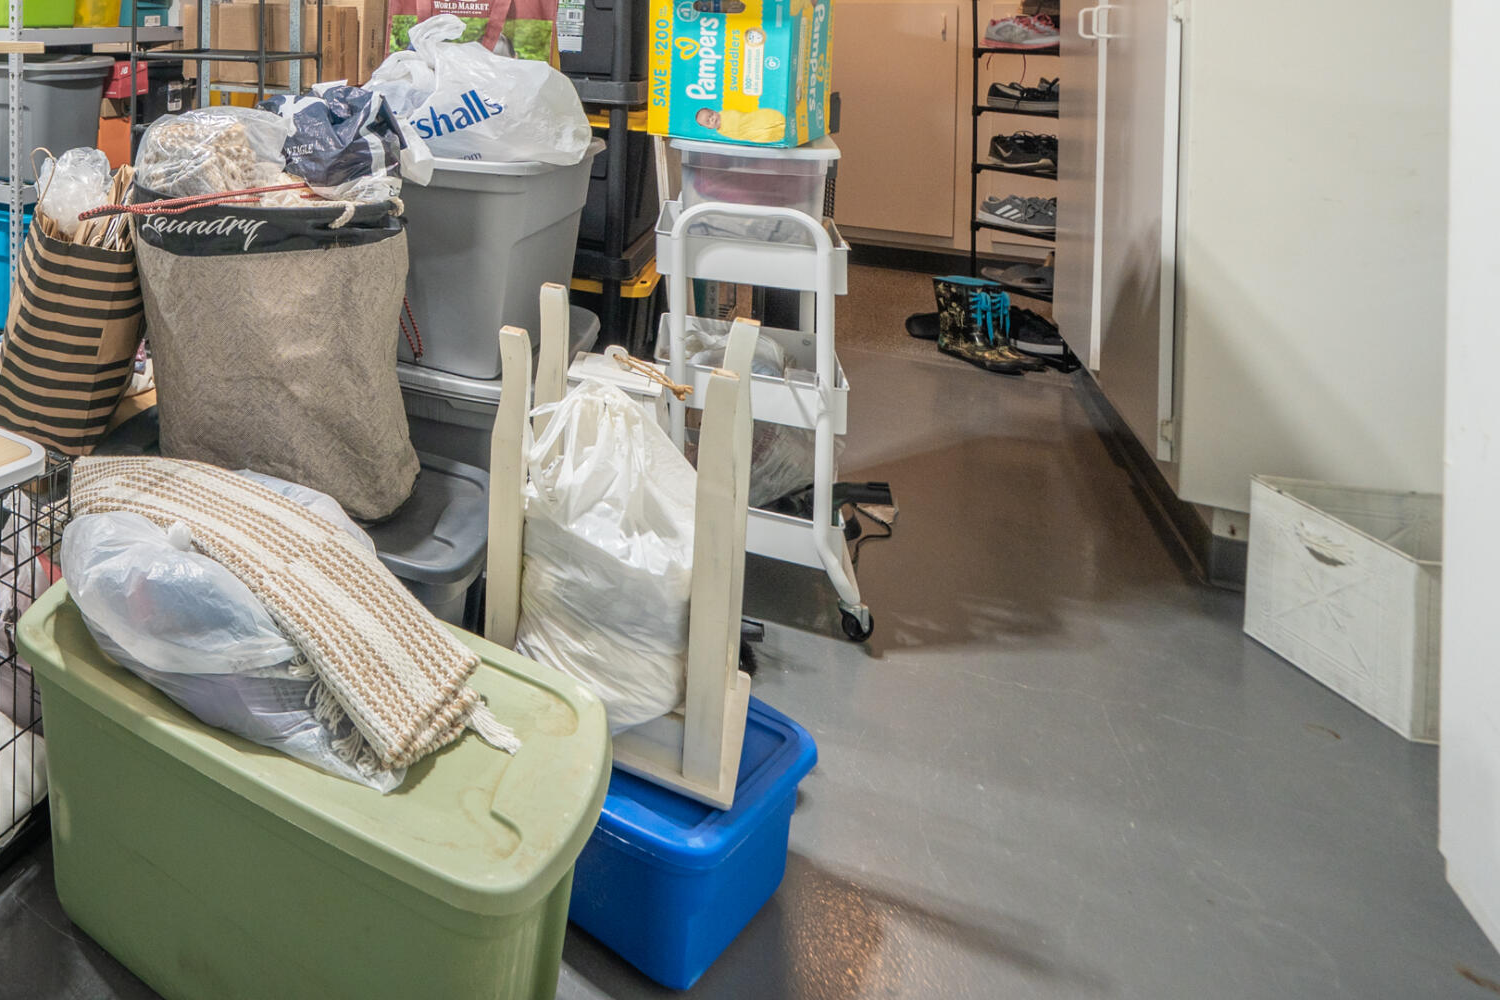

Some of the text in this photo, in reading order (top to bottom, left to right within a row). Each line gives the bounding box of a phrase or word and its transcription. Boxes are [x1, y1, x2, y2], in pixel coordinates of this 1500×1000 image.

[434, 0, 489, 11] WORLD MARKET
[655, 18, 670, 56] $200
[686, 17, 722, 100] Pampers
[809, 4, 825, 112] Pampers
[730, 29, 741, 92] swaddlers
[653, 68, 668, 107] SAVE
[410, 89, 503, 139] shalls
[141, 214, 268, 251] Laundry
